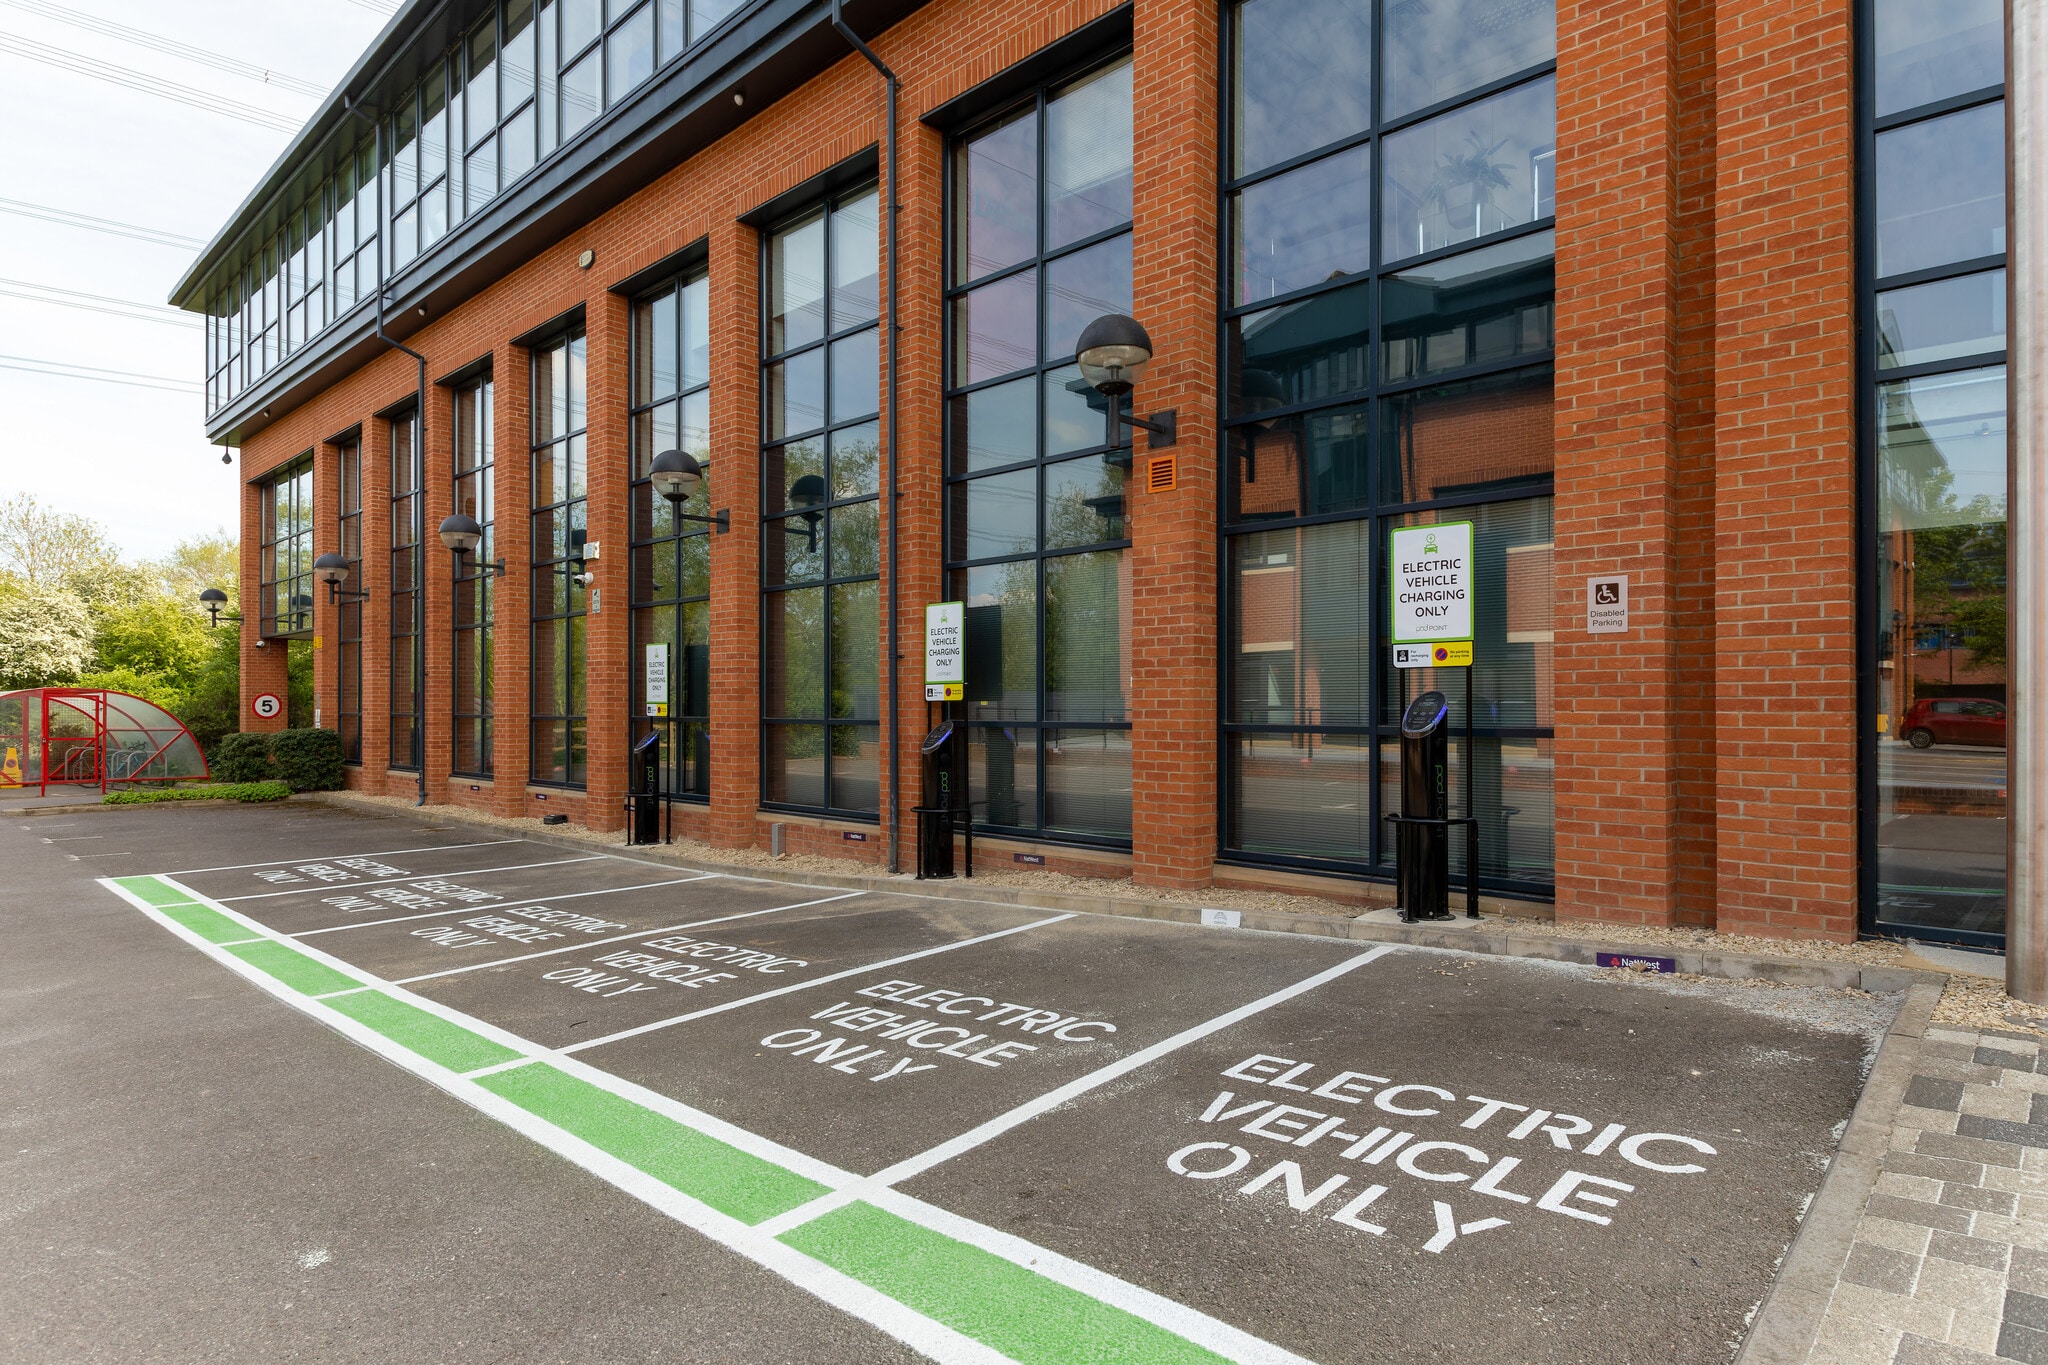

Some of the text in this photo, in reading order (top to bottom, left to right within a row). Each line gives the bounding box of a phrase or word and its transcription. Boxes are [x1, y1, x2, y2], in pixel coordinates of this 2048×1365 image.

[1402, 558, 1461, 573] ELECTRIC
[1406, 574, 1458, 588] VEHICLE
[1400, 589, 1465, 603] CHARGING
[1415, 606, 1449, 617] ONLY
[1590, 609, 1624, 617] Disabled
[931, 627, 958, 636] ELECTRIC
[1592, 619, 1622, 627] Parking
[932, 637, 956, 646] VEHICLE
[929, 648, 960, 656] CHARGING
[262, 700, 272, 713] 5
[253, 870, 308, 884] ONLY
[293, 864, 360, 881] VEHICLE
[333, 858, 412, 877] ELECTRIC
[365, 888, 448, 910] VEHICLE
[408, 880, 504, 904] ELECTRIC
[320, 896, 390, 912] ONLY
[458, 915, 565, 943] VEHICLE
[504, 906, 627, 934] ELECTRIC
[410, 926, 497, 949] ONLY
[641, 936, 808, 974] ELECTRIC
[592, 950, 738, 989] VEHICLE
[542, 967, 658, 997] ONLY
[855, 980, 1117, 1042] ELECTRIC
[809, 1002, 1039, 1067] VEHICLE
[760, 1028, 938, 1083] ONLY
[1220, 1054, 1717, 1174] ELECTRIC
[1200, 1091, 1635, 1226] VEHICLE
[1167, 1141, 1510, 1253] ONLY
